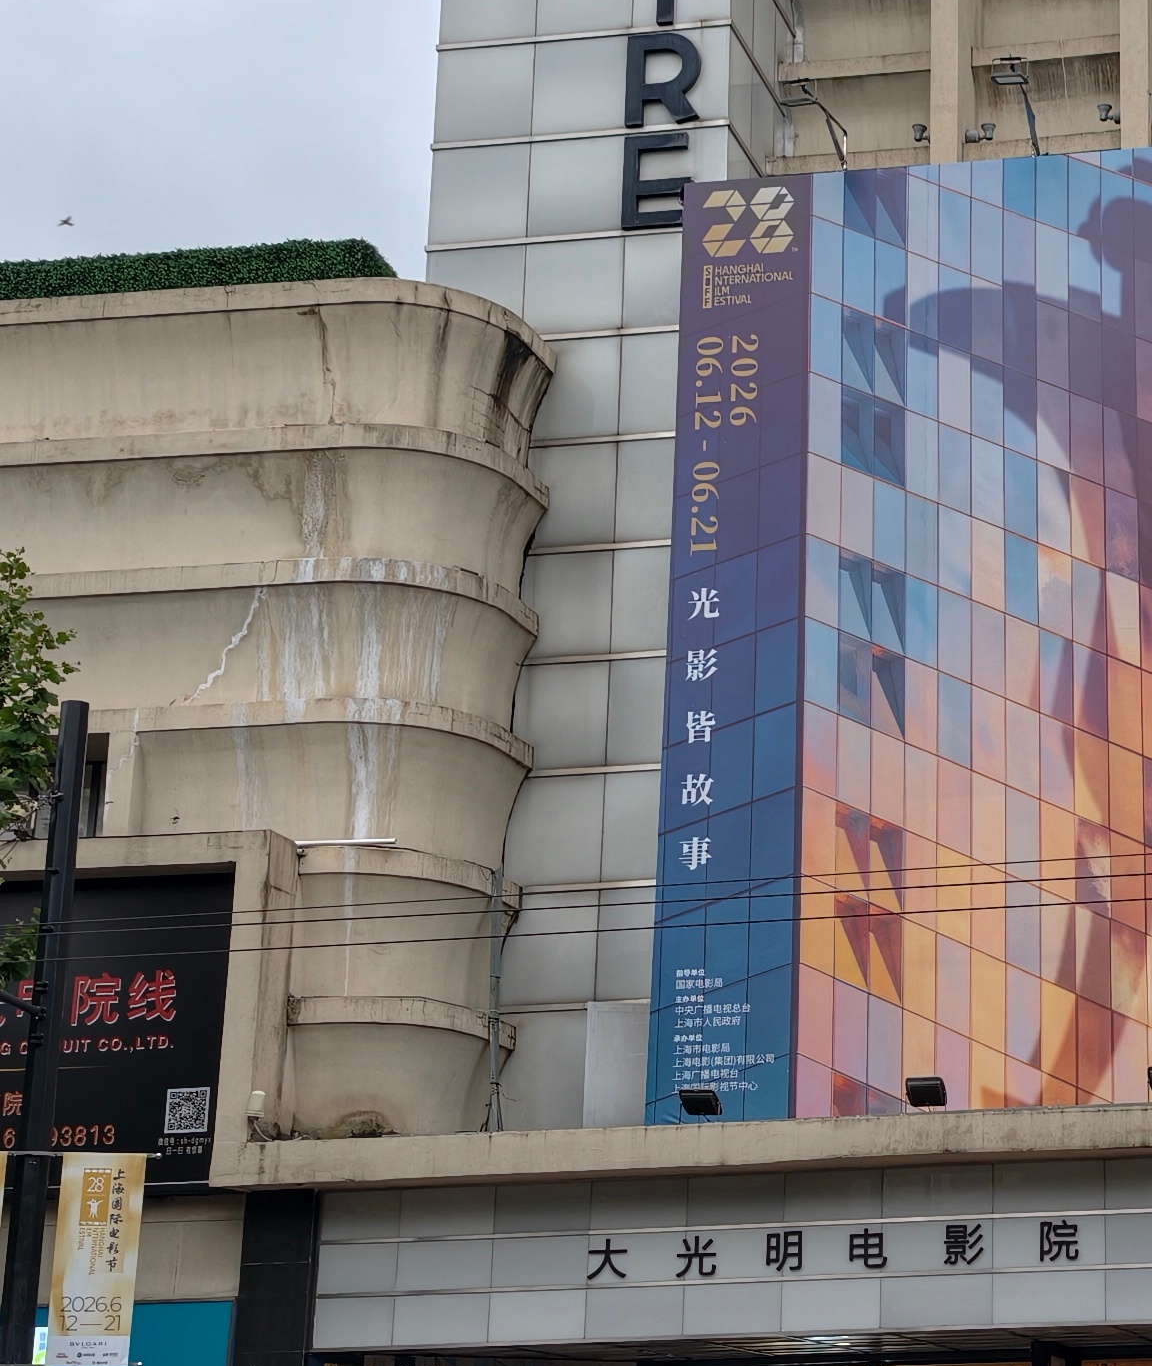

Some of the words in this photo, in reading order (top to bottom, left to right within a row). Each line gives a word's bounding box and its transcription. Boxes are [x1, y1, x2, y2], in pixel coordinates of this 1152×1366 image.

[702, 186, 795, 257] 28
[728, 334, 759, 427] 2026
[678, 587, 720, 870] 光影皆故事
[675, 977, 723, 990] 国家电影局
[674, 994, 705, 1004] 主办单位
[675, 1003, 751, 1016] 中央广播电视总台
[674, 1015, 742, 1029] 上海市人民政府
[673, 1033, 703, 1043] 承办单位
[673, 1042, 730, 1056] 上海市电影局
[671, 1068, 739, 1081] 上海广播电视台
[87, 1176, 105, 1192] 28
[586, 1219, 1080, 1280] 大光明电影院
[60, 1296, 122, 1312] 2026.6
